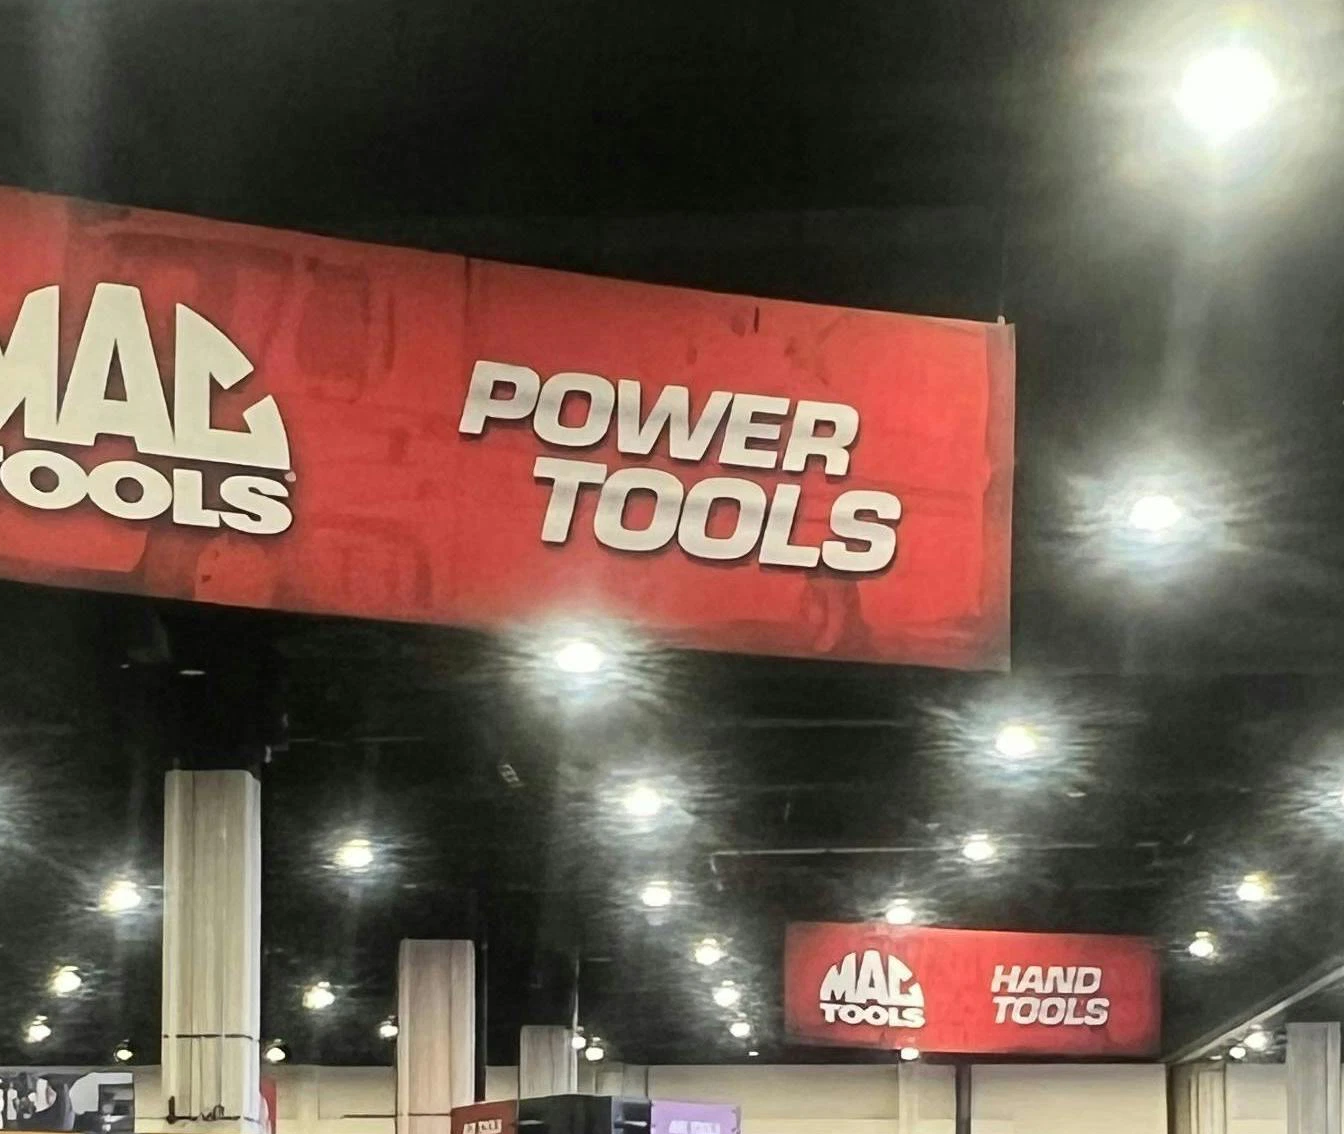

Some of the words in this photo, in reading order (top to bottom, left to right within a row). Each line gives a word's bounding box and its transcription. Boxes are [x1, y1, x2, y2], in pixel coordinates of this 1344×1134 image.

[458, 360, 860, 476] POWER
[532, 456, 903, 572] TOOLS
[820, 949, 925, 1007] MAC
[990, 965, 1102, 994] HAND
[820, 1002, 925, 1028] TOOLS
[992, 997, 1110, 1027] TOOLS
